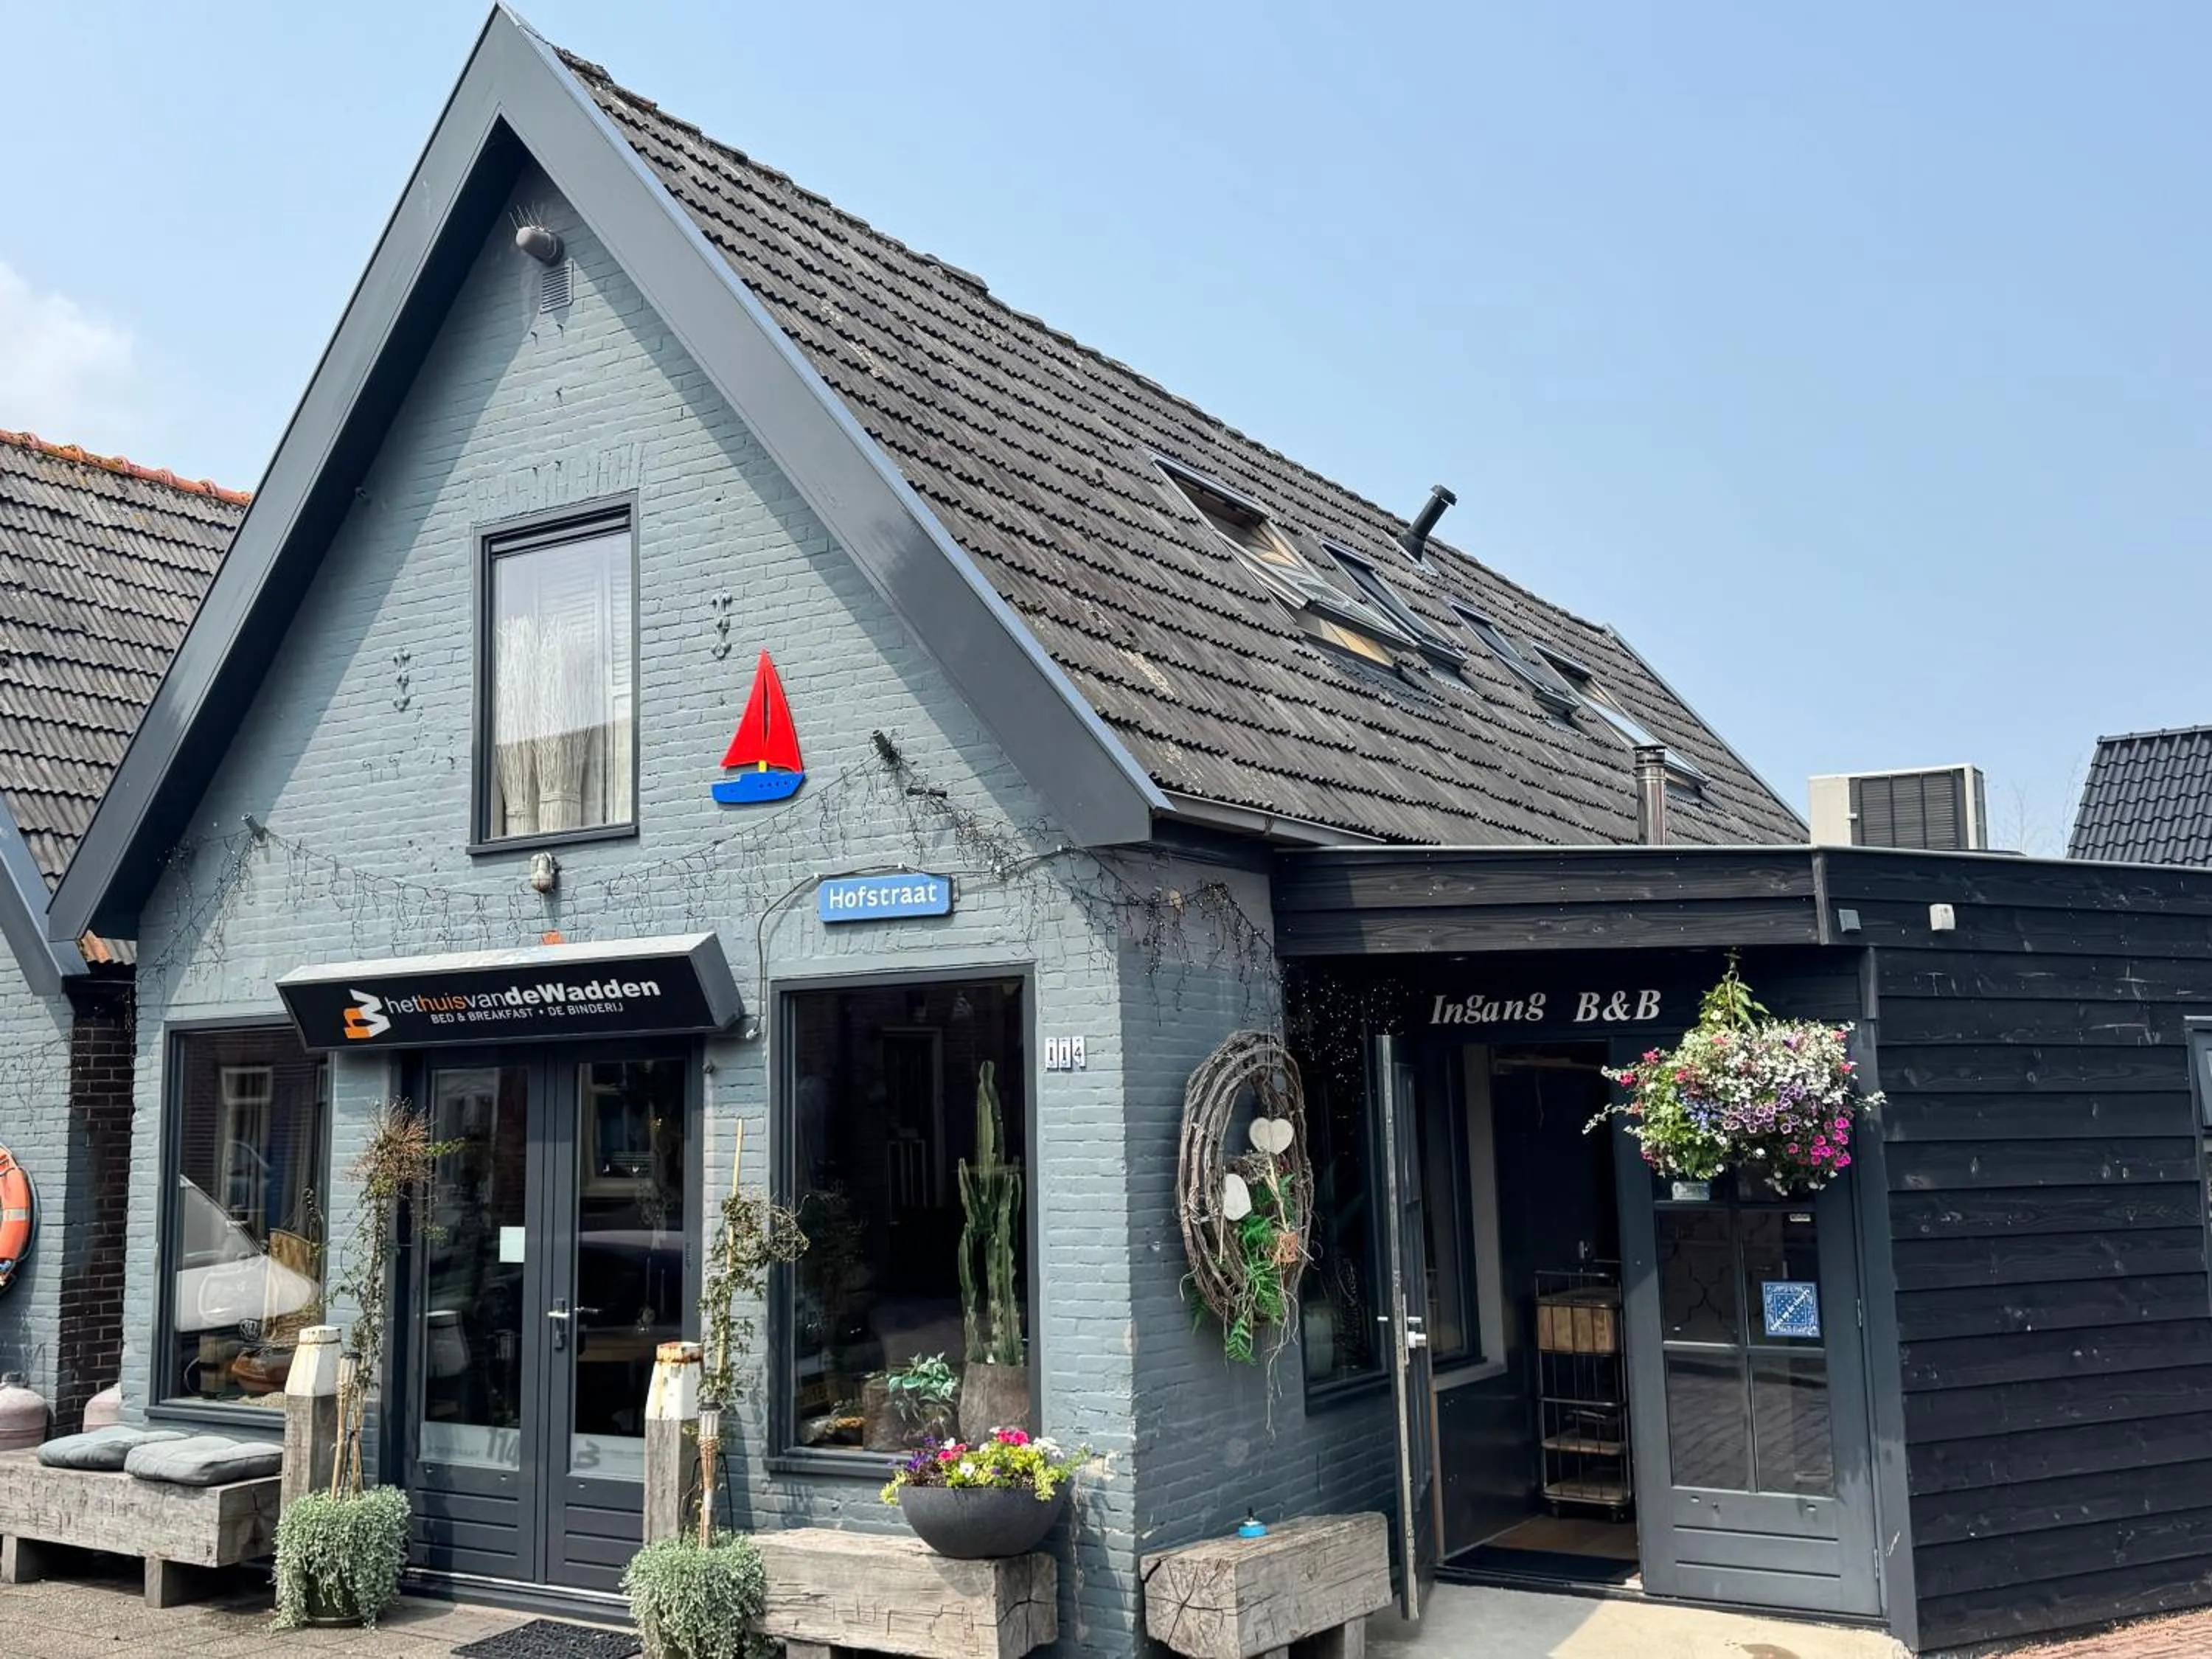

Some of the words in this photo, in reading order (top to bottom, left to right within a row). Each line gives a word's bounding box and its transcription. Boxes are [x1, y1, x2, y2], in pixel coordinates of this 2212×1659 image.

[829, 883, 938, 909] Hofstraat
[431, 1012, 456, 1024] BED
[456, 1012, 466, 1023] &
[467, 1007, 533, 1022] BREAKFAST
[547, 1006, 566, 1017] DE
[567, 1001, 624, 1016] BINDERIJ
[1428, 991, 1547, 1024] Ingang
[1572, 989, 1661, 1023] B&B
[1049, 1046, 1082, 1061] 114
